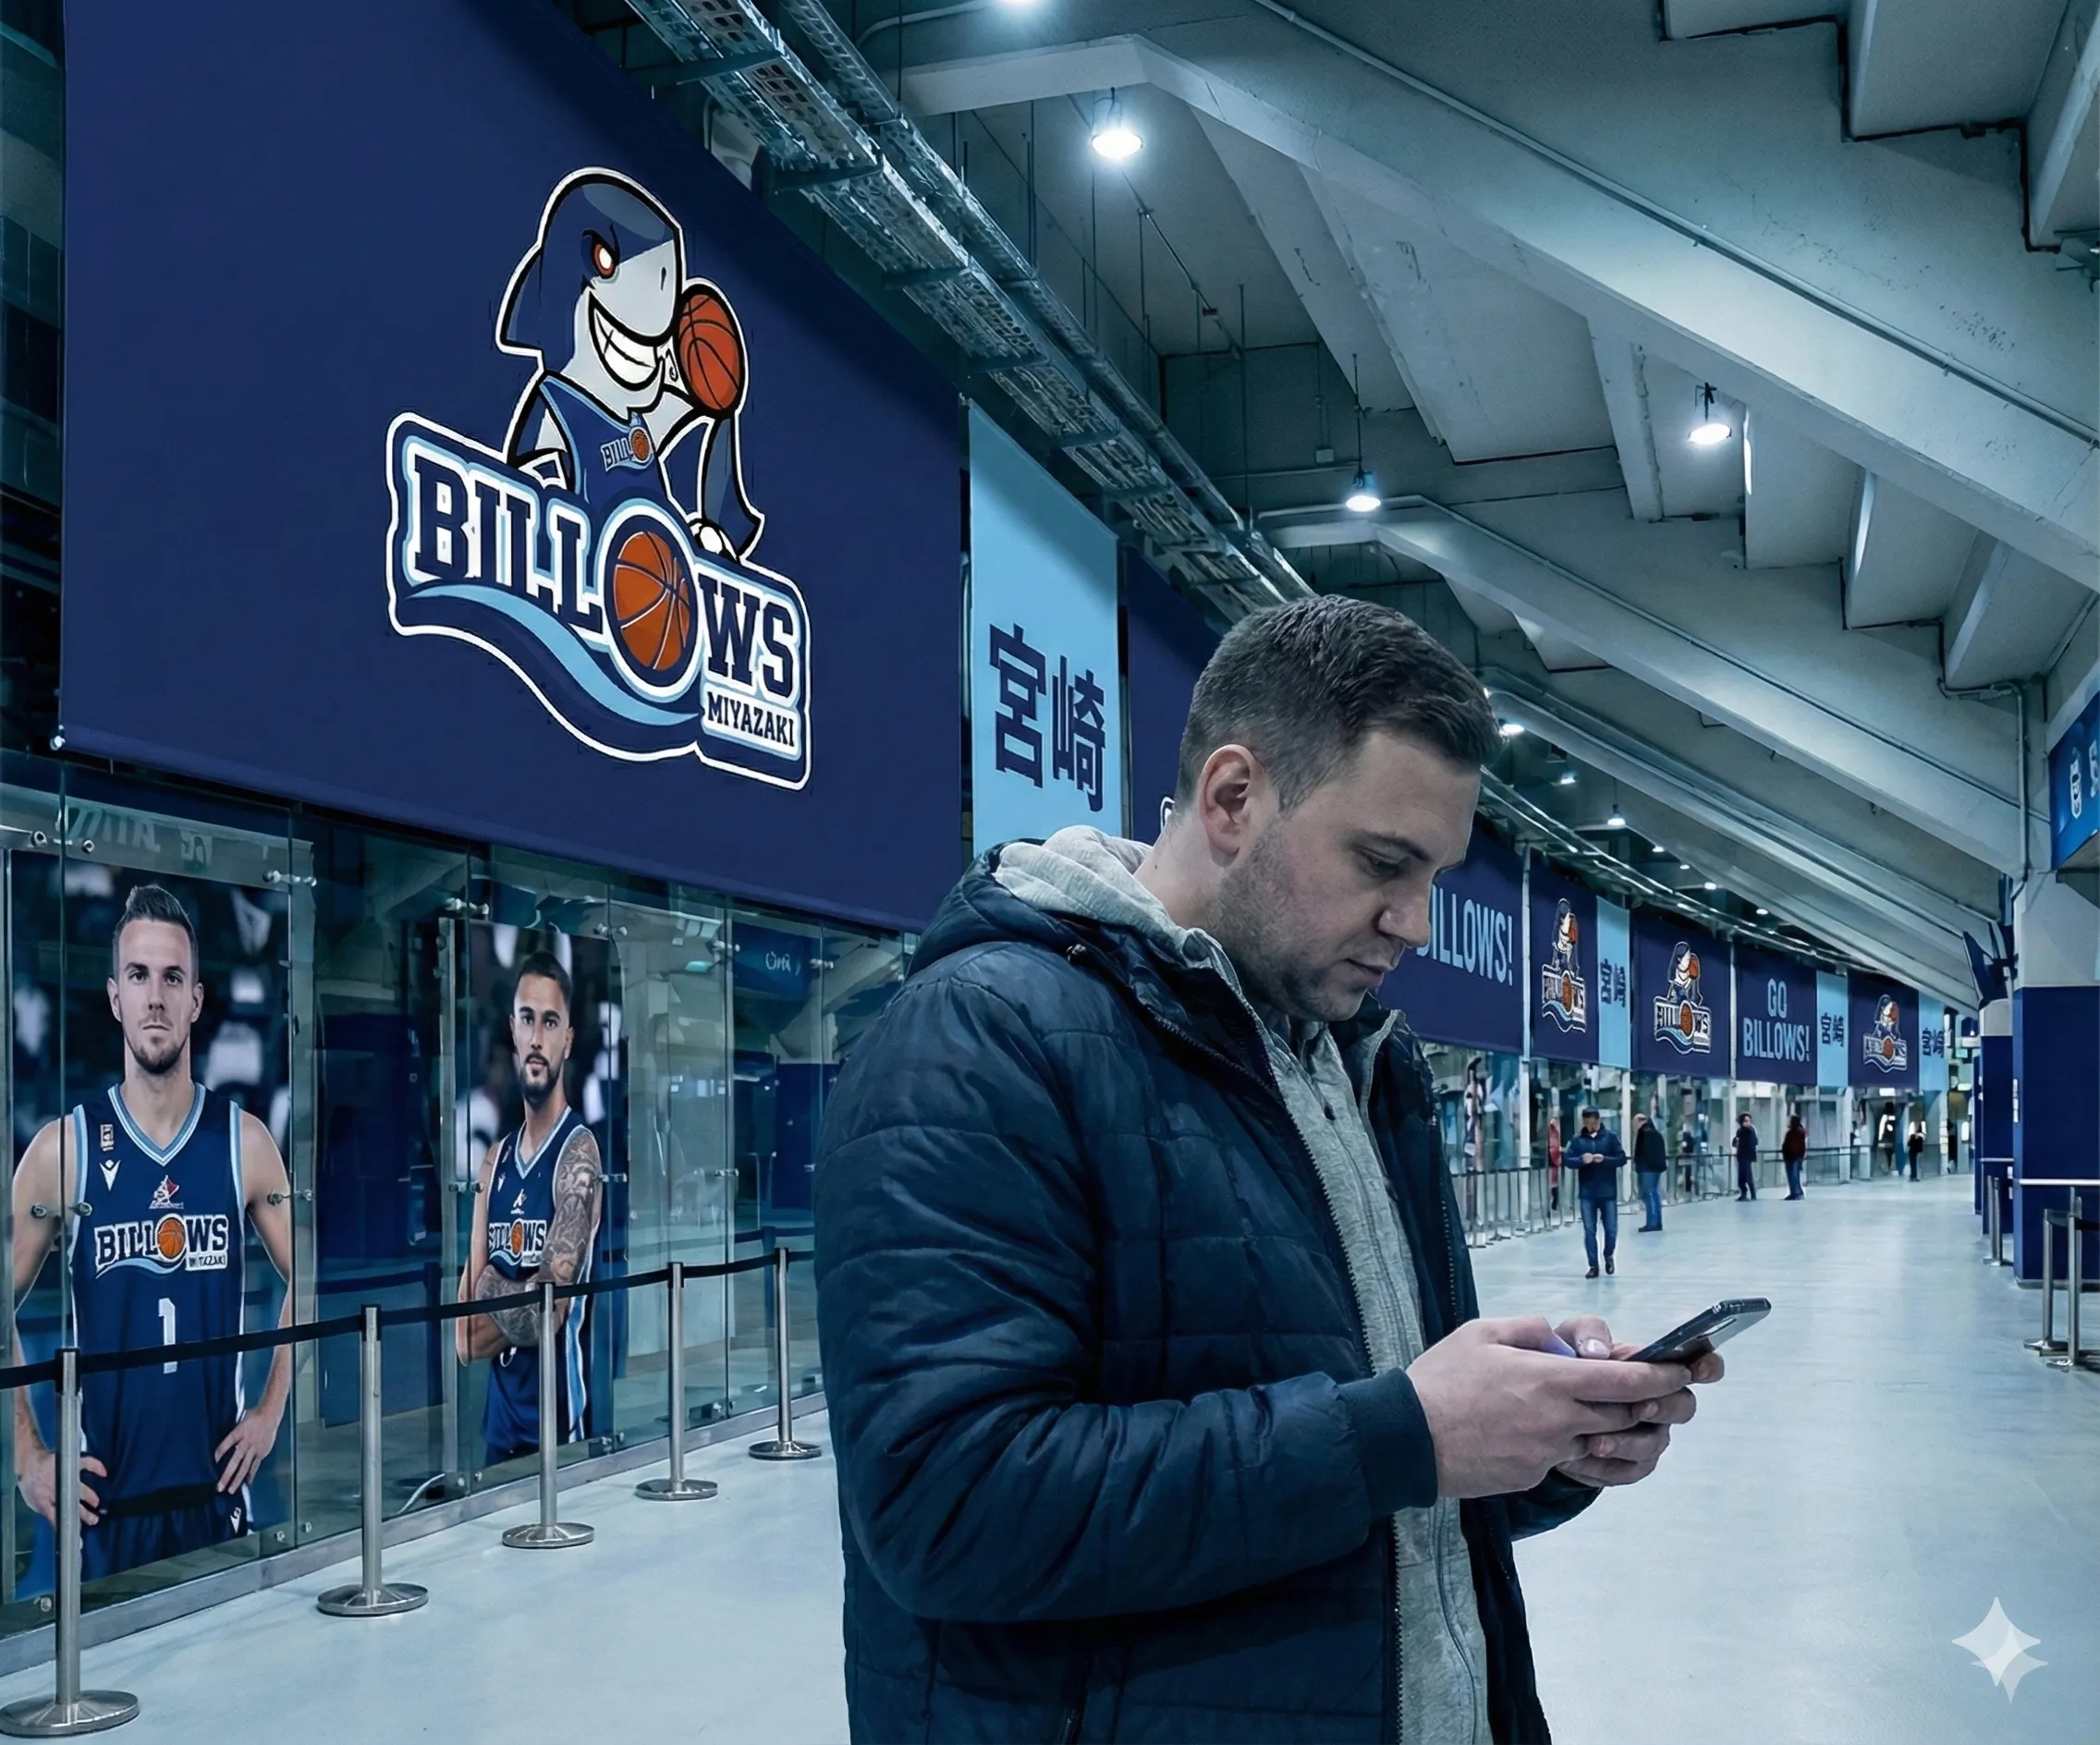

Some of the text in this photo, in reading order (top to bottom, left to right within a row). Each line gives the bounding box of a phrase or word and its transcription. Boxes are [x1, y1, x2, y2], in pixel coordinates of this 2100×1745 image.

[412, 455, 795, 701] BILLOWS
[705, 689, 796, 749] MIYAZAKI
[988, 622, 1106, 812] 宮崎
[1416, 883, 1513, 986] ILLOWS!
[1766, 978, 1788, 1019] GO
[1742, 1017, 1811, 1062] BILLOWS!
[95, 1214, 228, 1267] BILLOWS
[158, 1297, 178, 1374] 1
